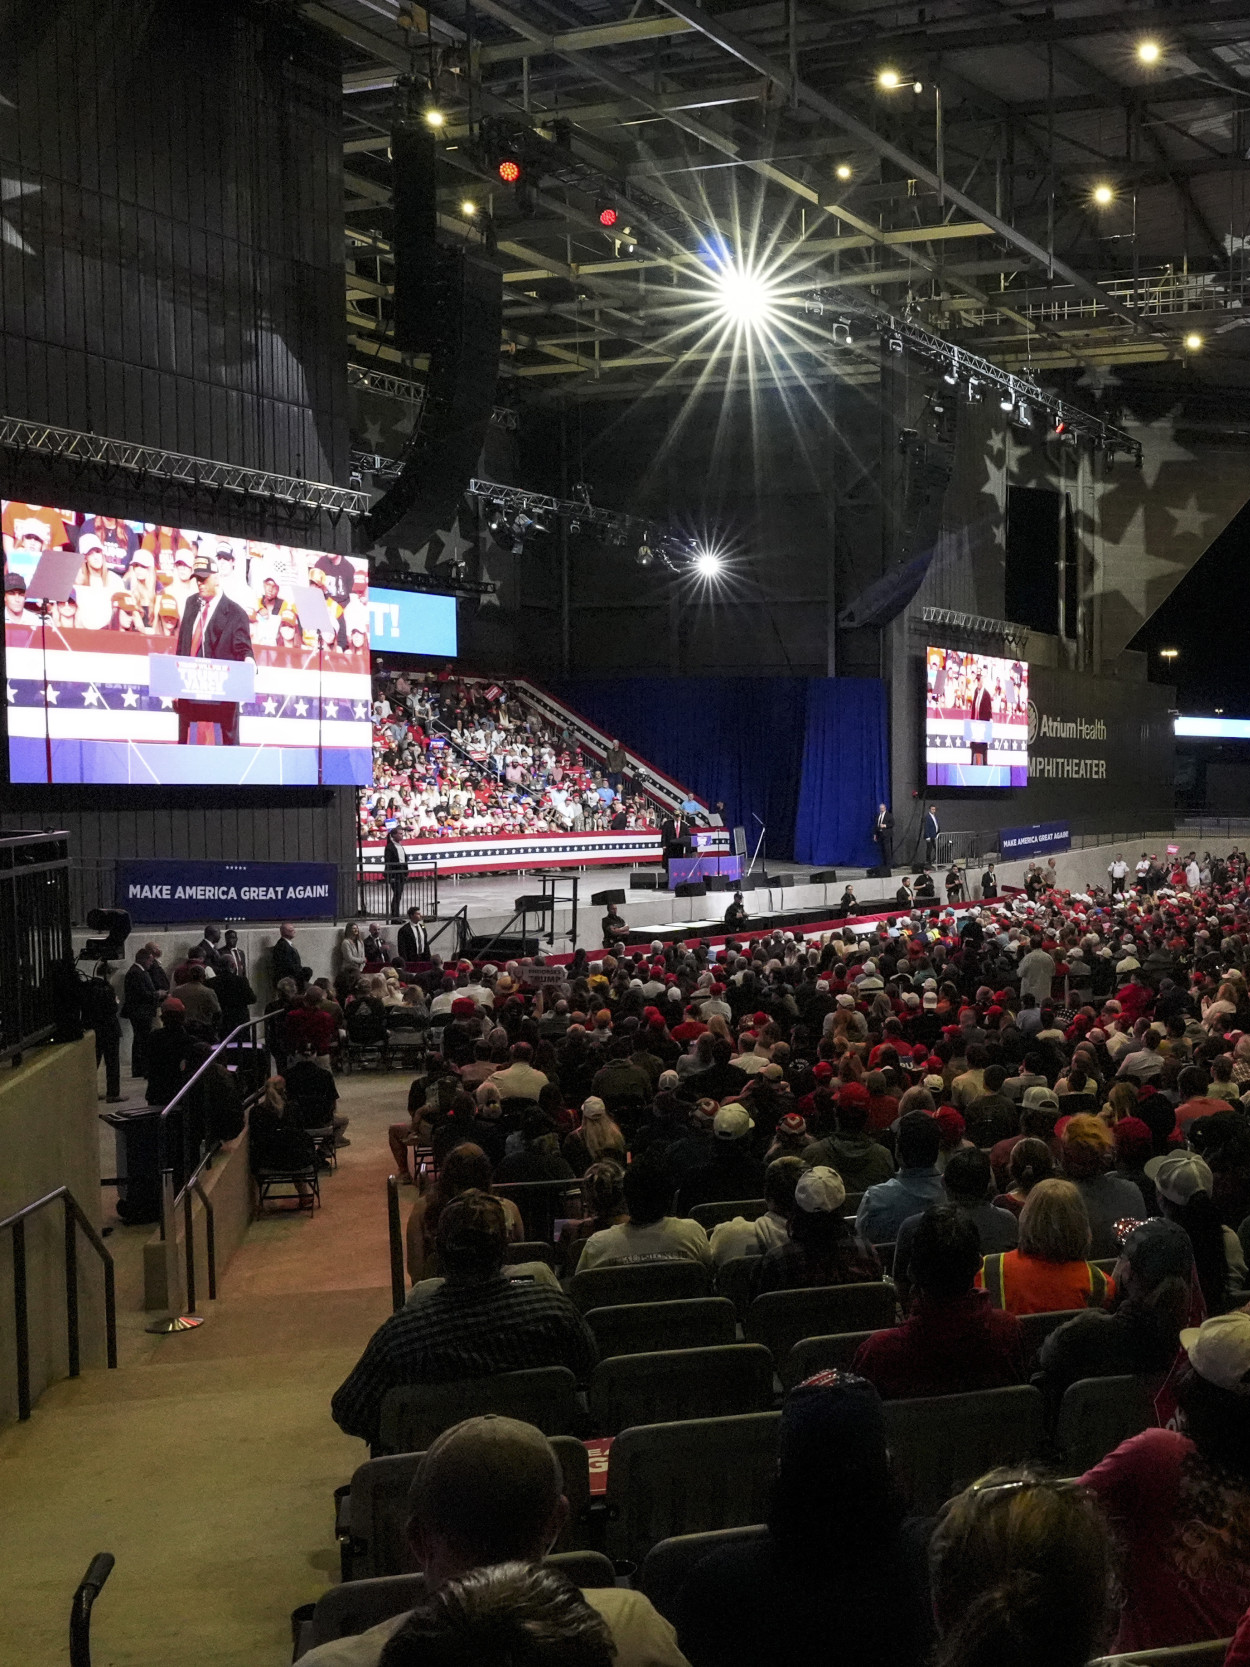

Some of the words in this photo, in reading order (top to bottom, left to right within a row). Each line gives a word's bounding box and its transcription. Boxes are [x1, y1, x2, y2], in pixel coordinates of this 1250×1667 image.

[368, 601, 400, 637] T!
[1040, 714, 1076, 738] Atrium
[1077, 717, 1107, 740] Health
[1027, 757, 1106, 778] MPHITHEATER
[1003, 838, 1017, 848] MAKE
[1017, 835, 1038, 845] AMERICA
[1038, 833, 1053, 842] GREAT
[129, 885, 171, 898] MAKE
[174, 886, 237, 900] AMERICA
[240, 887, 284, 900] GREAT
[286, 884, 329, 898] AGAIN!
